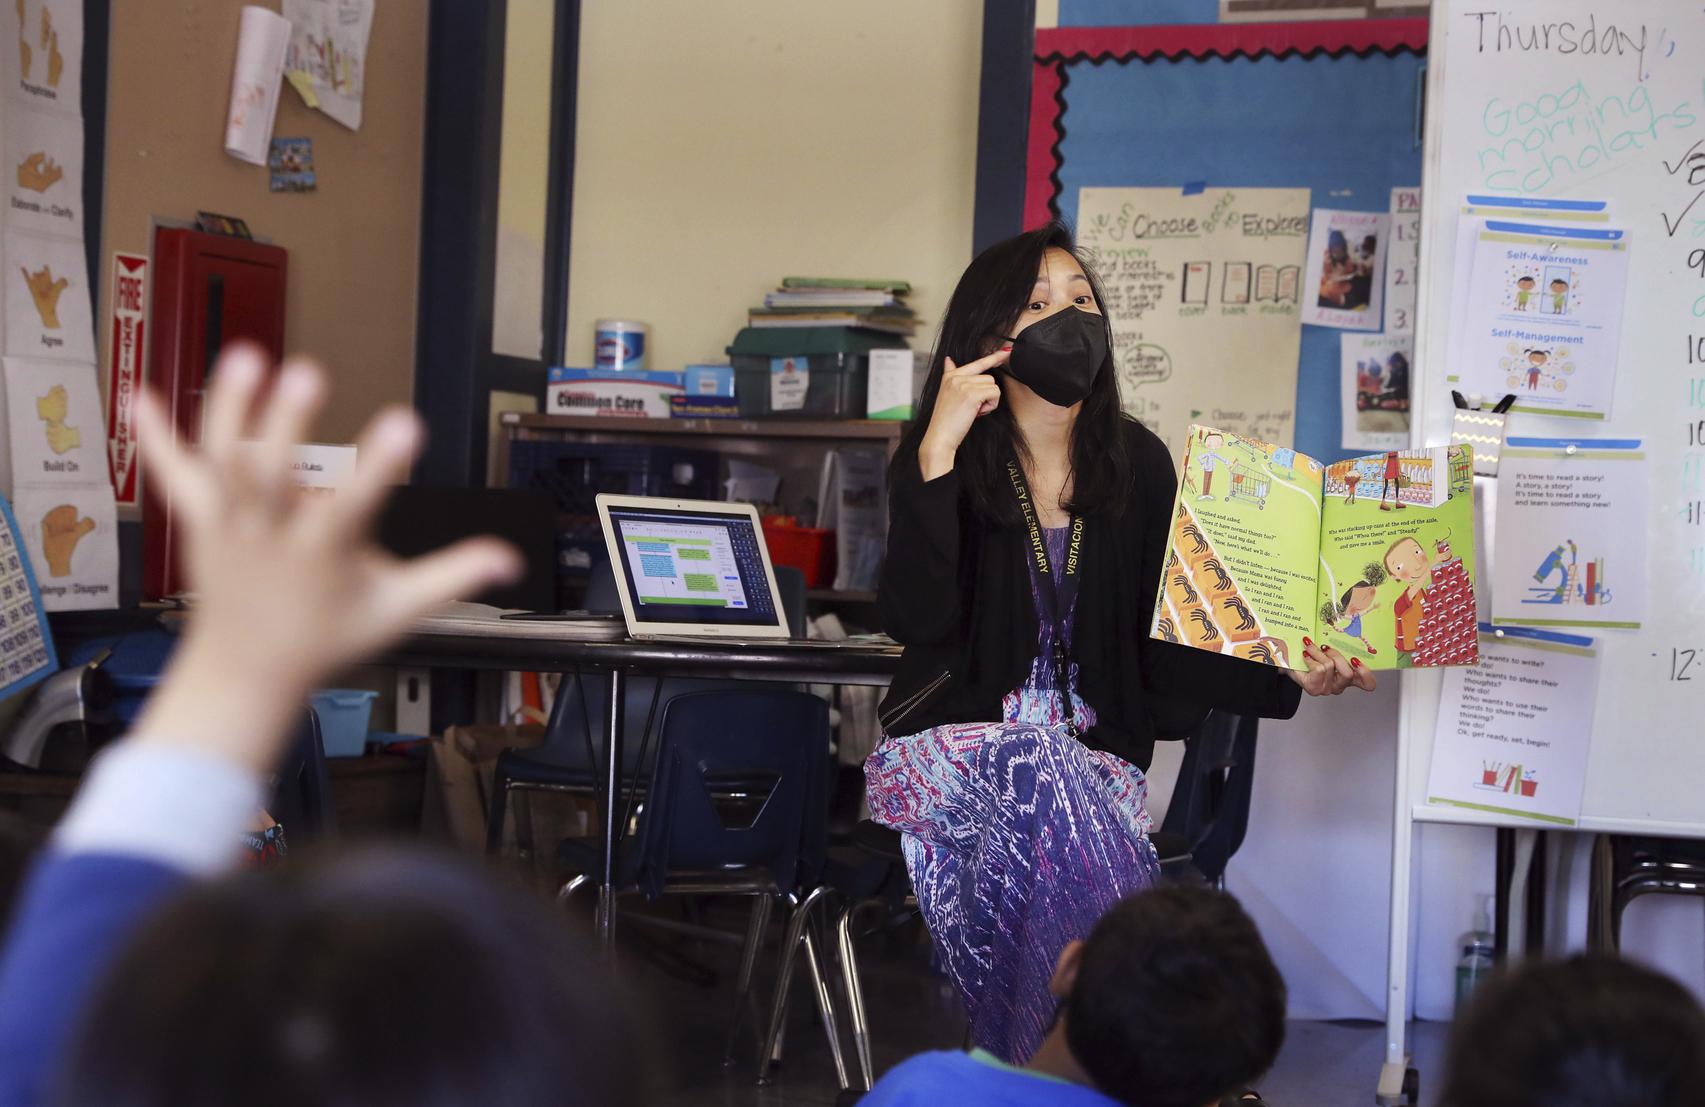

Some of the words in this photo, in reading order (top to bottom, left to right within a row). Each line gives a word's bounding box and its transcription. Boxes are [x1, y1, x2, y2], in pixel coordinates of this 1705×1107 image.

[1483, 80, 1590, 137] Good
[1132, 213, 1199, 239] Choose
[1506, 250, 1589, 265] Self-Awareness
[41, 335, 64, 349] Agree
[1491, 328, 1585, 344] Self-Management
[615, 395, 645, 411] Core
[43, 460, 65, 472] Build
[67, 461, 80, 472] On
[1006, 460, 1028, 500] VALLEY
[1021, 502, 1049, 574] ELEMENTARY
[1198, 508, 1216, 518] laughed
[1217, 513, 1226, 521] and
[1230, 526, 1248, 534] normal
[1248, 530, 1263, 538] things
[1066, 515, 1084, 576] VISITACION
[1230, 565, 1249, 574] Because
[1250, 562, 1263, 570] listen
[1270, 566, 1288, 575] because
[1265, 617, 1284, 626] bumped
[1488, 655, 1510, 663] wants
[1522, 660, 1544, 668] write?
[1464, 677, 1502, 687] thoughts?
[1485, 672, 1507, 680] wants
[1519, 676, 1540, 685] share
[1541, 679, 1559, 687] their
[1462, 694, 1480, 702] Who
[1482, 697, 1503, 706] wants
[1530, 704, 1548, 712] their
[1459, 711, 1494, 722] thinking?
[1461, 704, 1483, 712] words
[1495, 707, 1515, 716] share
[1517, 711, 1535, 719] their
[1458, 719, 1471, 727] We
[1472, 721, 1486, 729] do!
[1486, 733, 1510, 743] ready,
[1526, 738, 1551, 748] begin!
